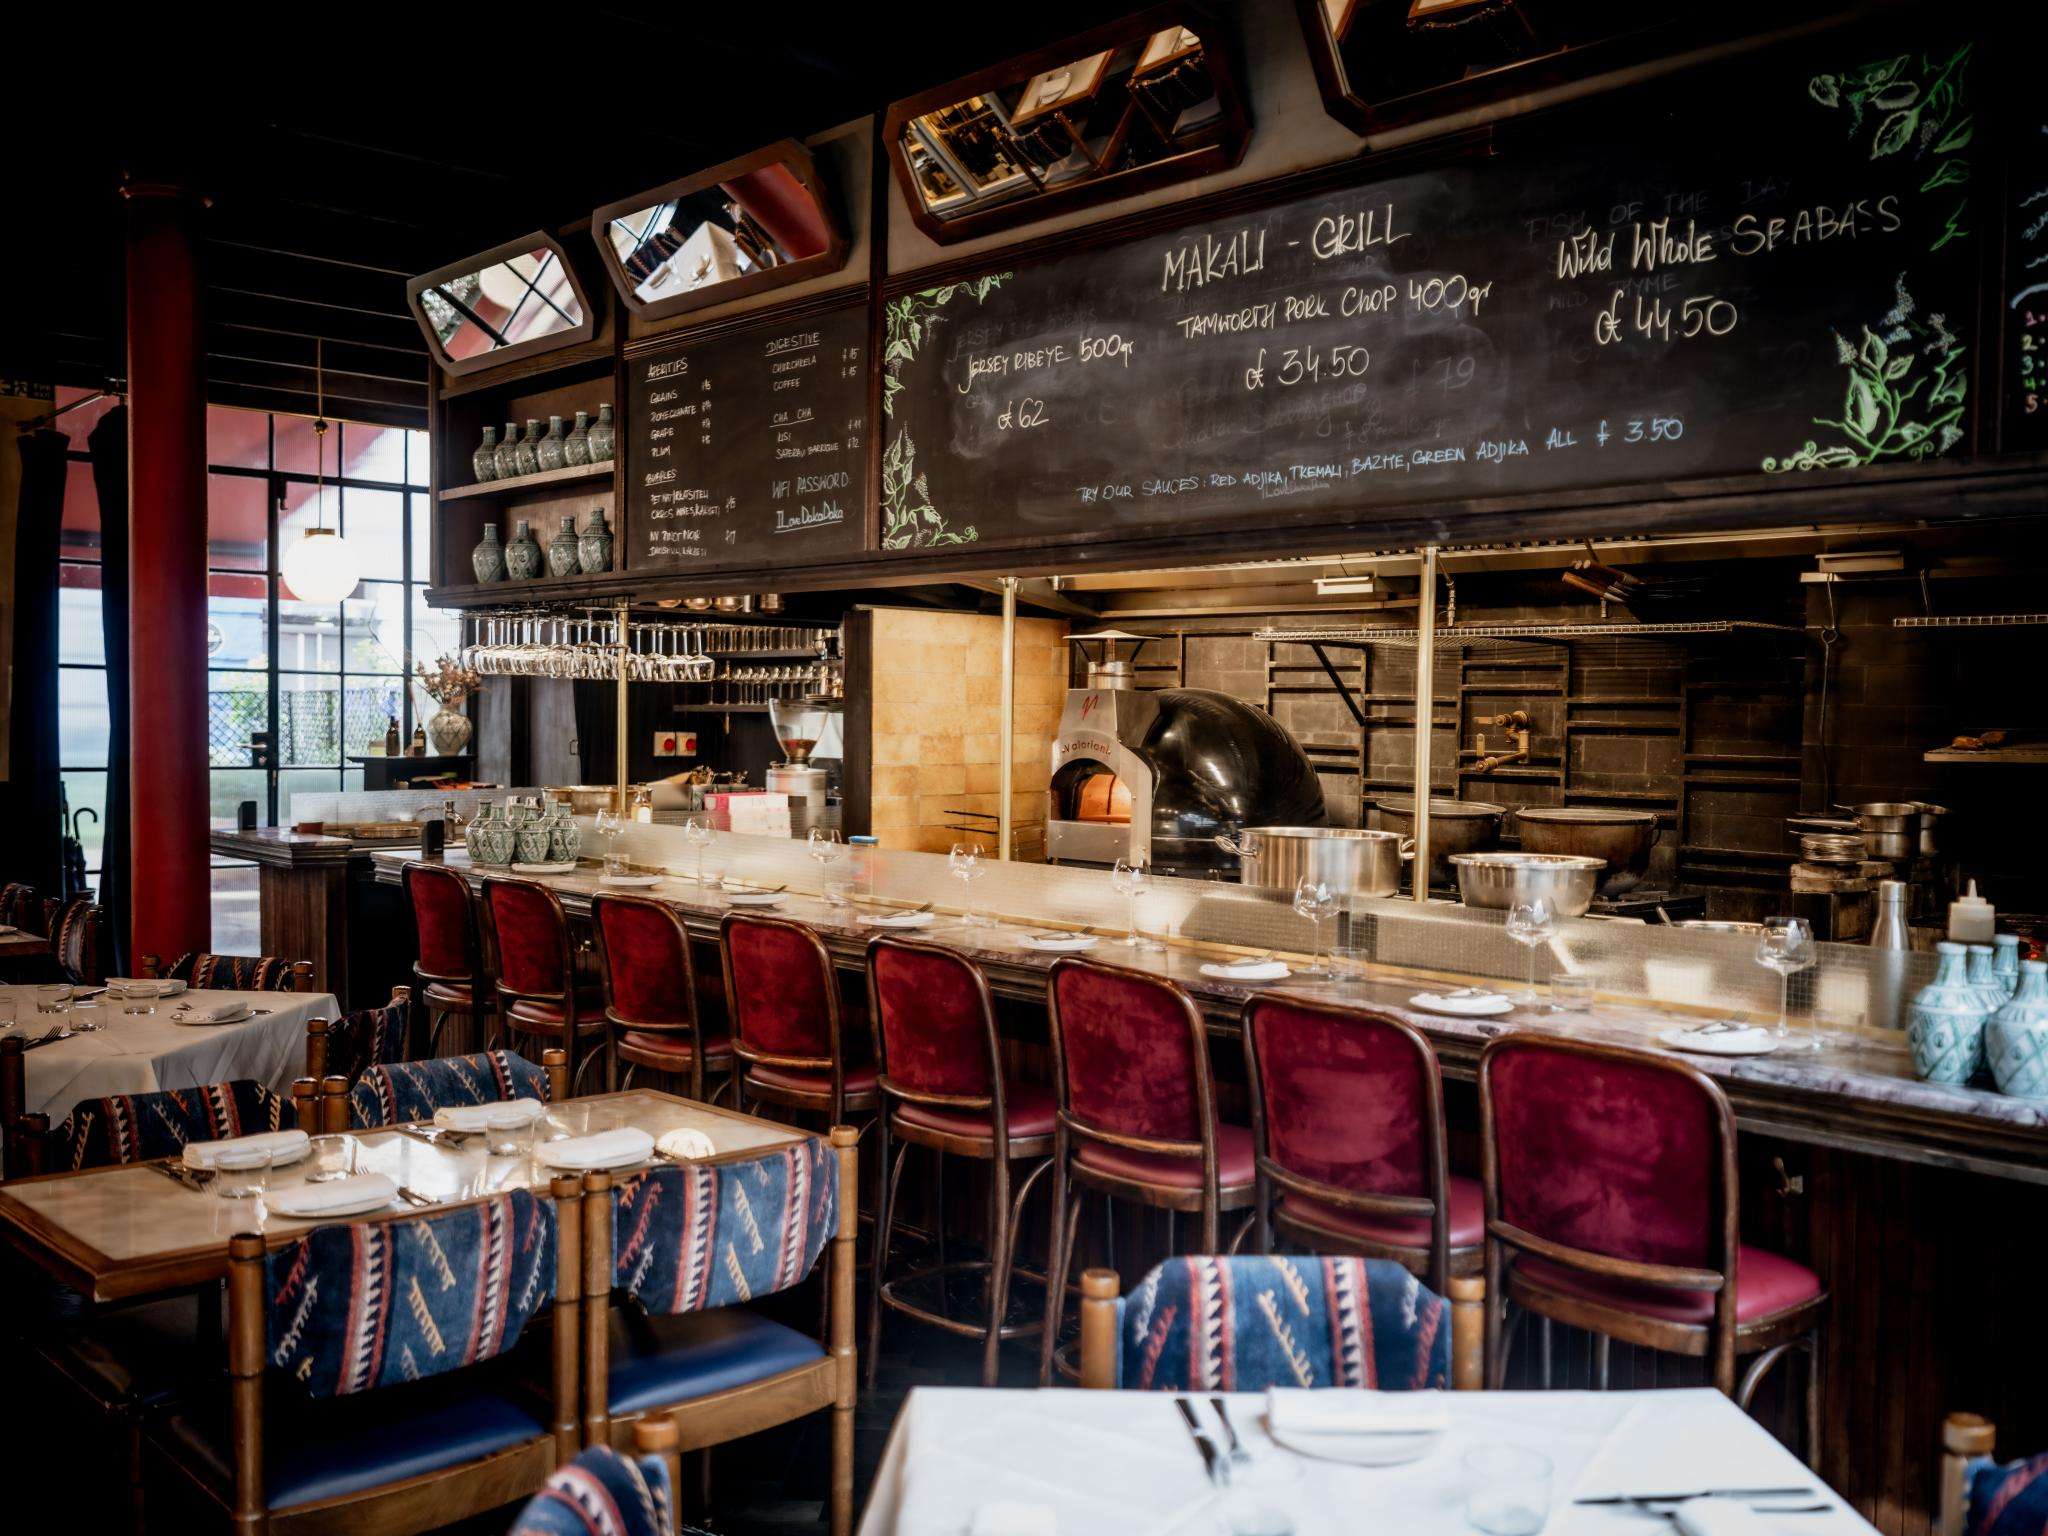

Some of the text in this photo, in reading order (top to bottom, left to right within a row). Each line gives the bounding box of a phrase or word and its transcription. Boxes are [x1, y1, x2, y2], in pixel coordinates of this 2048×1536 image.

[1161, 230, 1267, 292] MAKALI
[1312, 203, 1413, 259] GRILL
[1177, 301, 1277, 339] TAMWORTH
[1285, 294, 1331, 322] PORK
[766, 332, 821, 354] DIGESTIVE
[958, 354, 1010, 394] JERSEY
[1014, 345, 1072, 371] RIBEYE
[1075, 485, 1099, 503] TRY
[1102, 484, 1134, 500] OUR
[1210, 474, 1237, 487] RED
[1412, 448, 1466, 464] GREEN
[1476, 438, 1529, 463] ADJIKA
[1545, 427, 1578, 450] ALL
